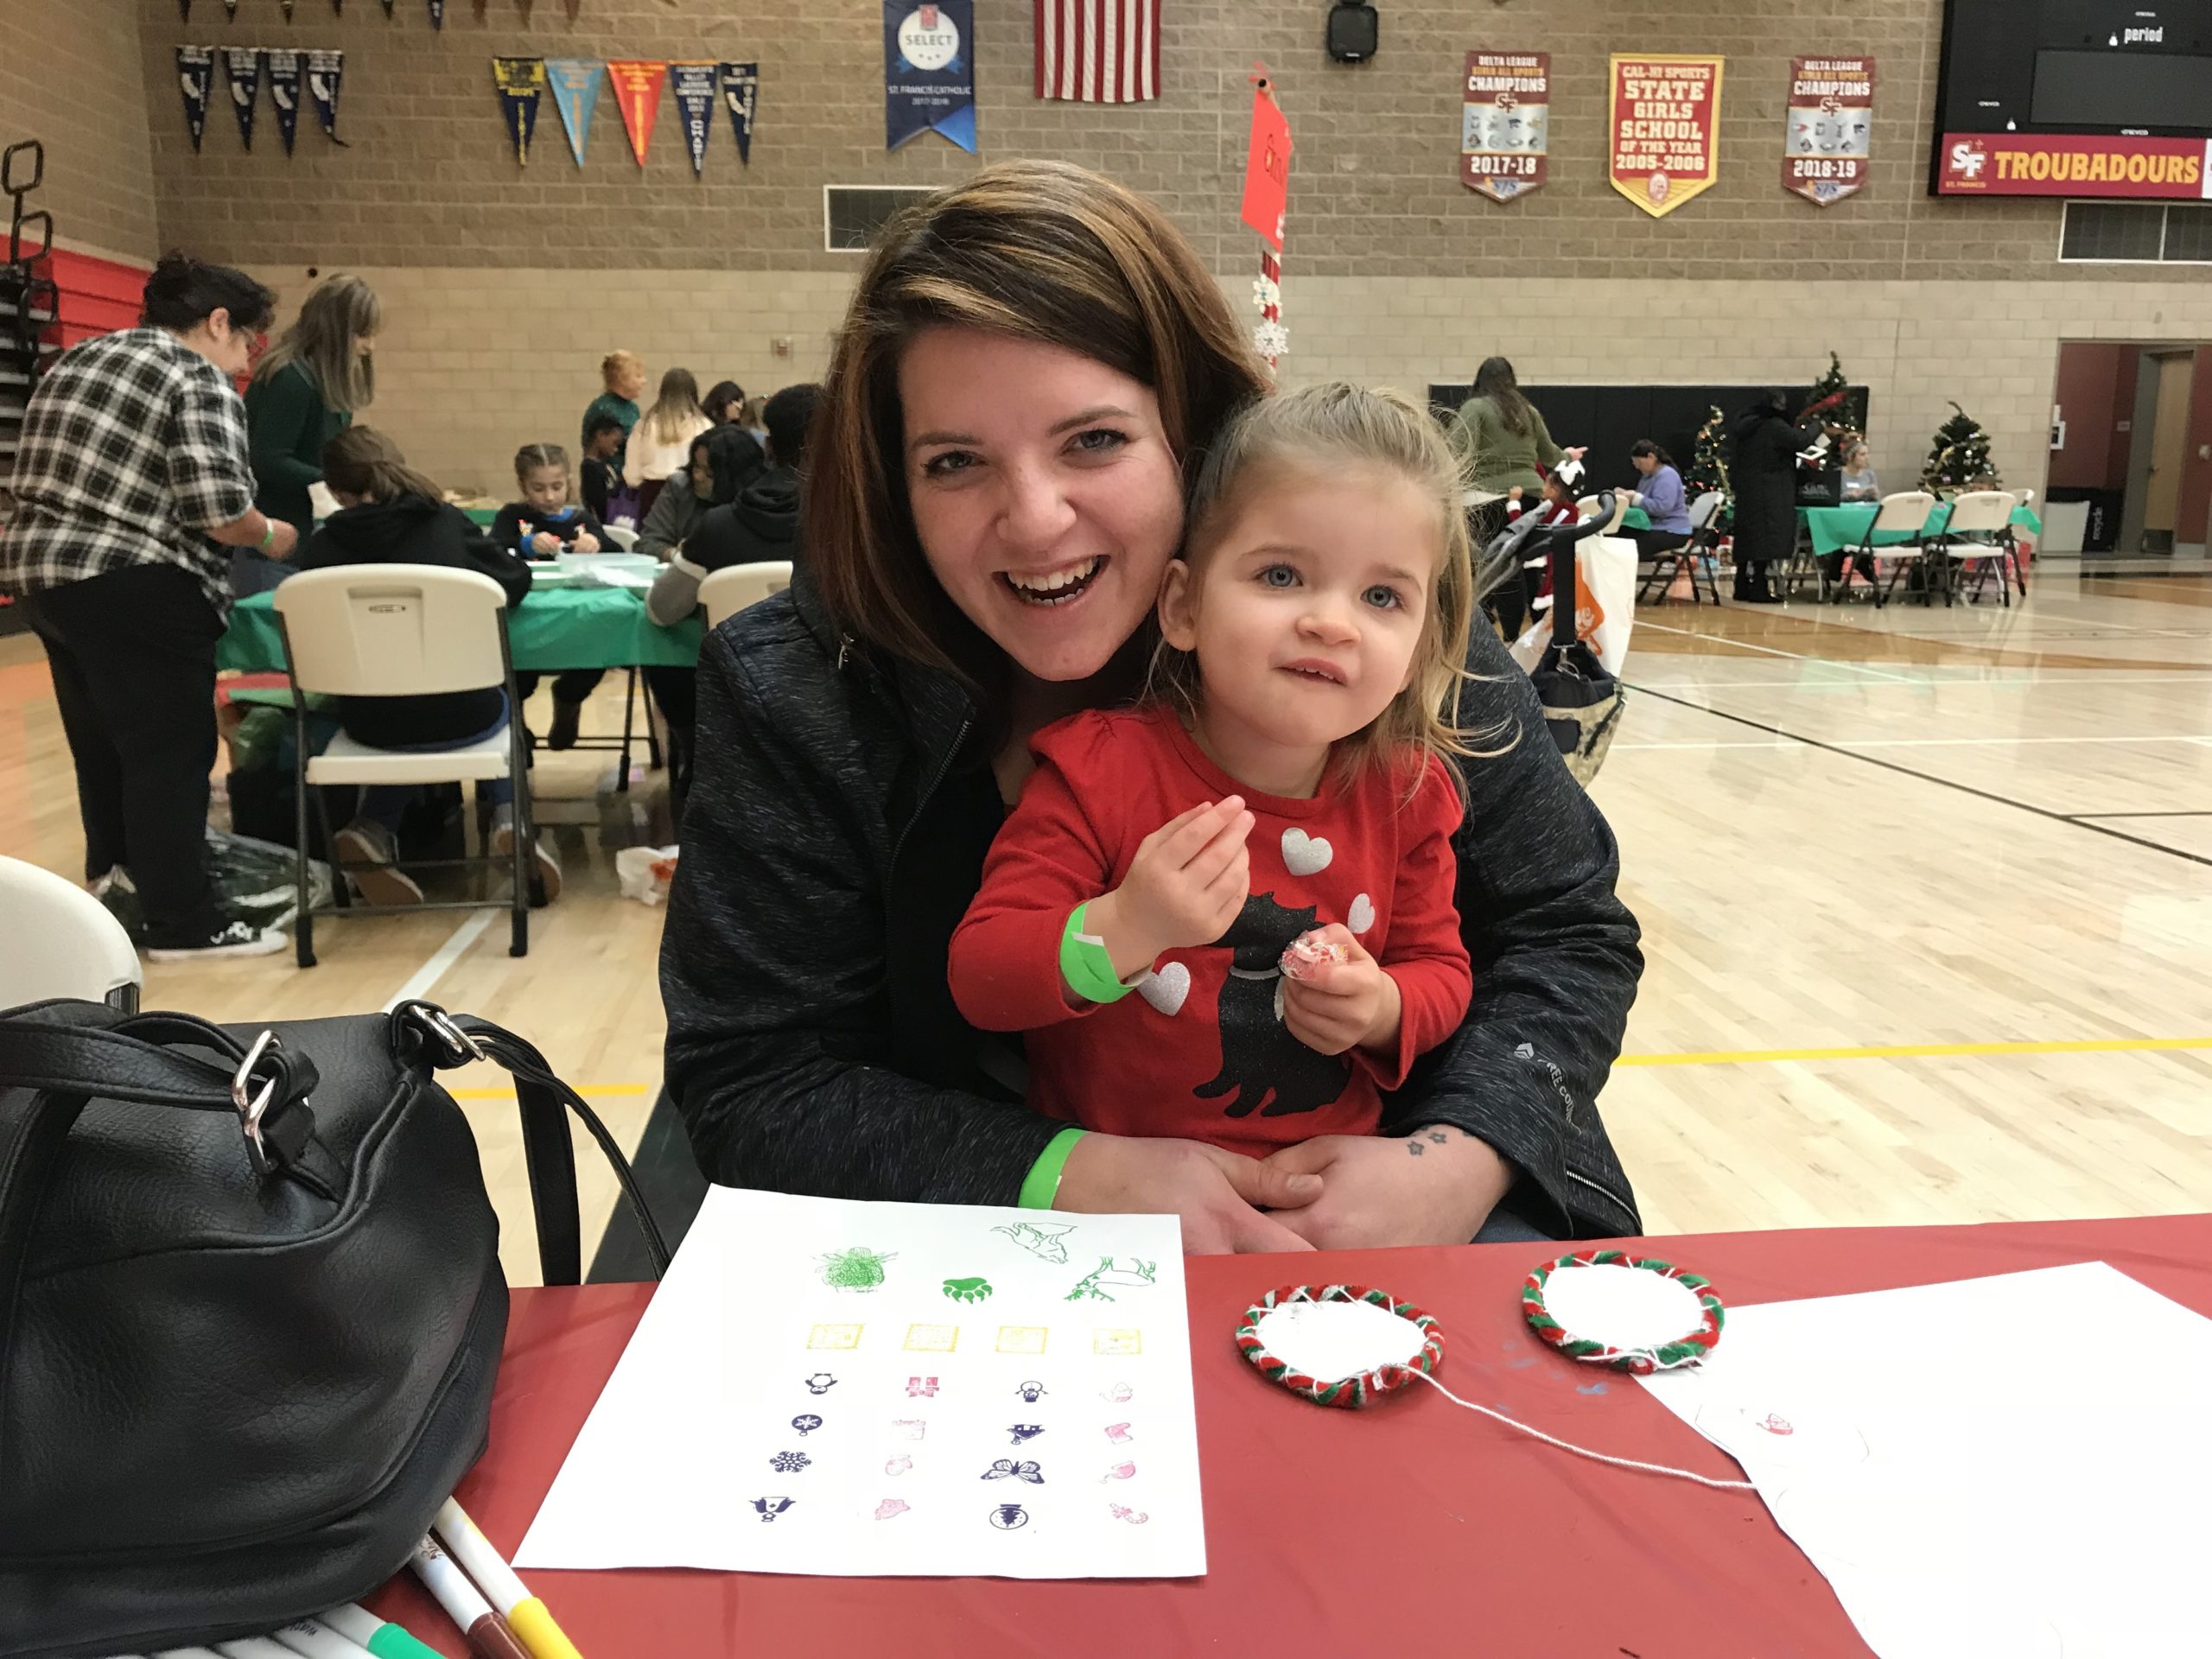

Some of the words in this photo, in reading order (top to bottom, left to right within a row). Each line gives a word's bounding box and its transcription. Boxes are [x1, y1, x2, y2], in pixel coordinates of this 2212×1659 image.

[905, 35, 953, 46] SELECT
[2124, 27, 2164, 44] period
[1478, 55, 1505, 66] DELTA
[1506, 56, 1538, 67] LEAGUE
[1804, 60, 1830, 71] DELTA
[1832, 60, 1863, 71] LEAGUE
[1623, 66, 1663, 78] CAL-HI
[1664, 67, 1711, 79] SPORTS
[900, 86, 932, 94] FRANCIS
[933, 86, 971, 95] CATHOLIC
[1468, 76, 1546, 92] CHAMPIONS
[1624, 79, 1706, 101] STATE
[1794, 80, 1871, 96] CHAMPIONS
[1634, 102, 1694, 119] GIRLS
[1620, 120, 1703, 140] SCHOOL
[1620, 141, 1637, 152] OF
[1640, 141, 1666, 153] THE
[1669, 142, 1702, 154] YEAR
[1471, 156, 1536, 175] 2017-18
[1616, 154, 1705, 171] 2005-2006
[1951, 143, 1985, 177] SF
[1994, 151, 2200, 184] TROUBADOURS
[1793, 160, 1857, 178] 2018-19
